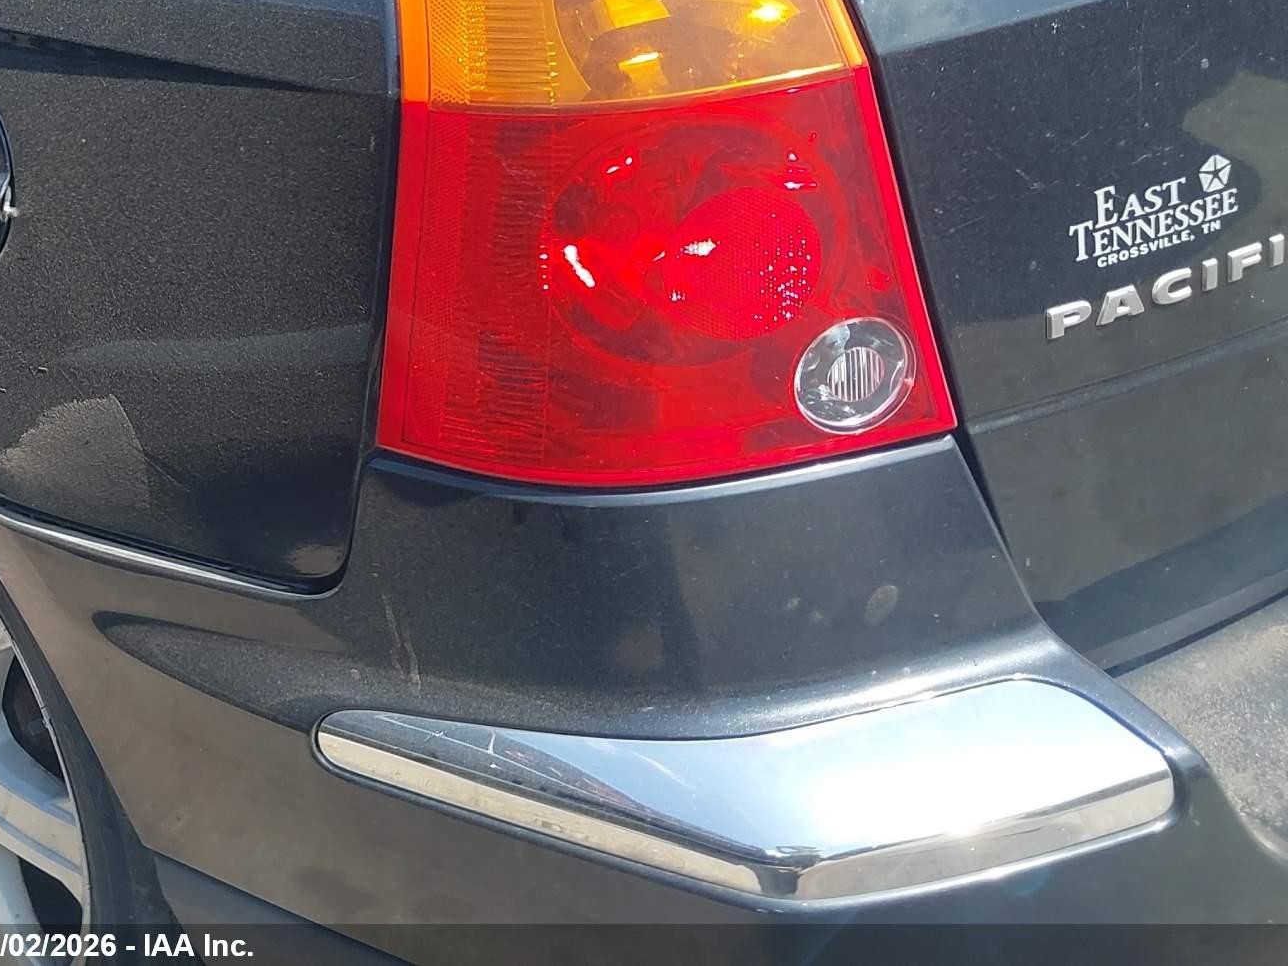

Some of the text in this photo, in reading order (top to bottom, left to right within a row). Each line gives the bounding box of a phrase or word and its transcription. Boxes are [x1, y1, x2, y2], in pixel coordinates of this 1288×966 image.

[1068, 188, 1239, 262] TENNESSEE
[1094, 176, 1187, 229] EAST
[1096, 219, 1222, 268] CROSSVILLE, TN
[1044, 233, 1287, 340] PACIFI
